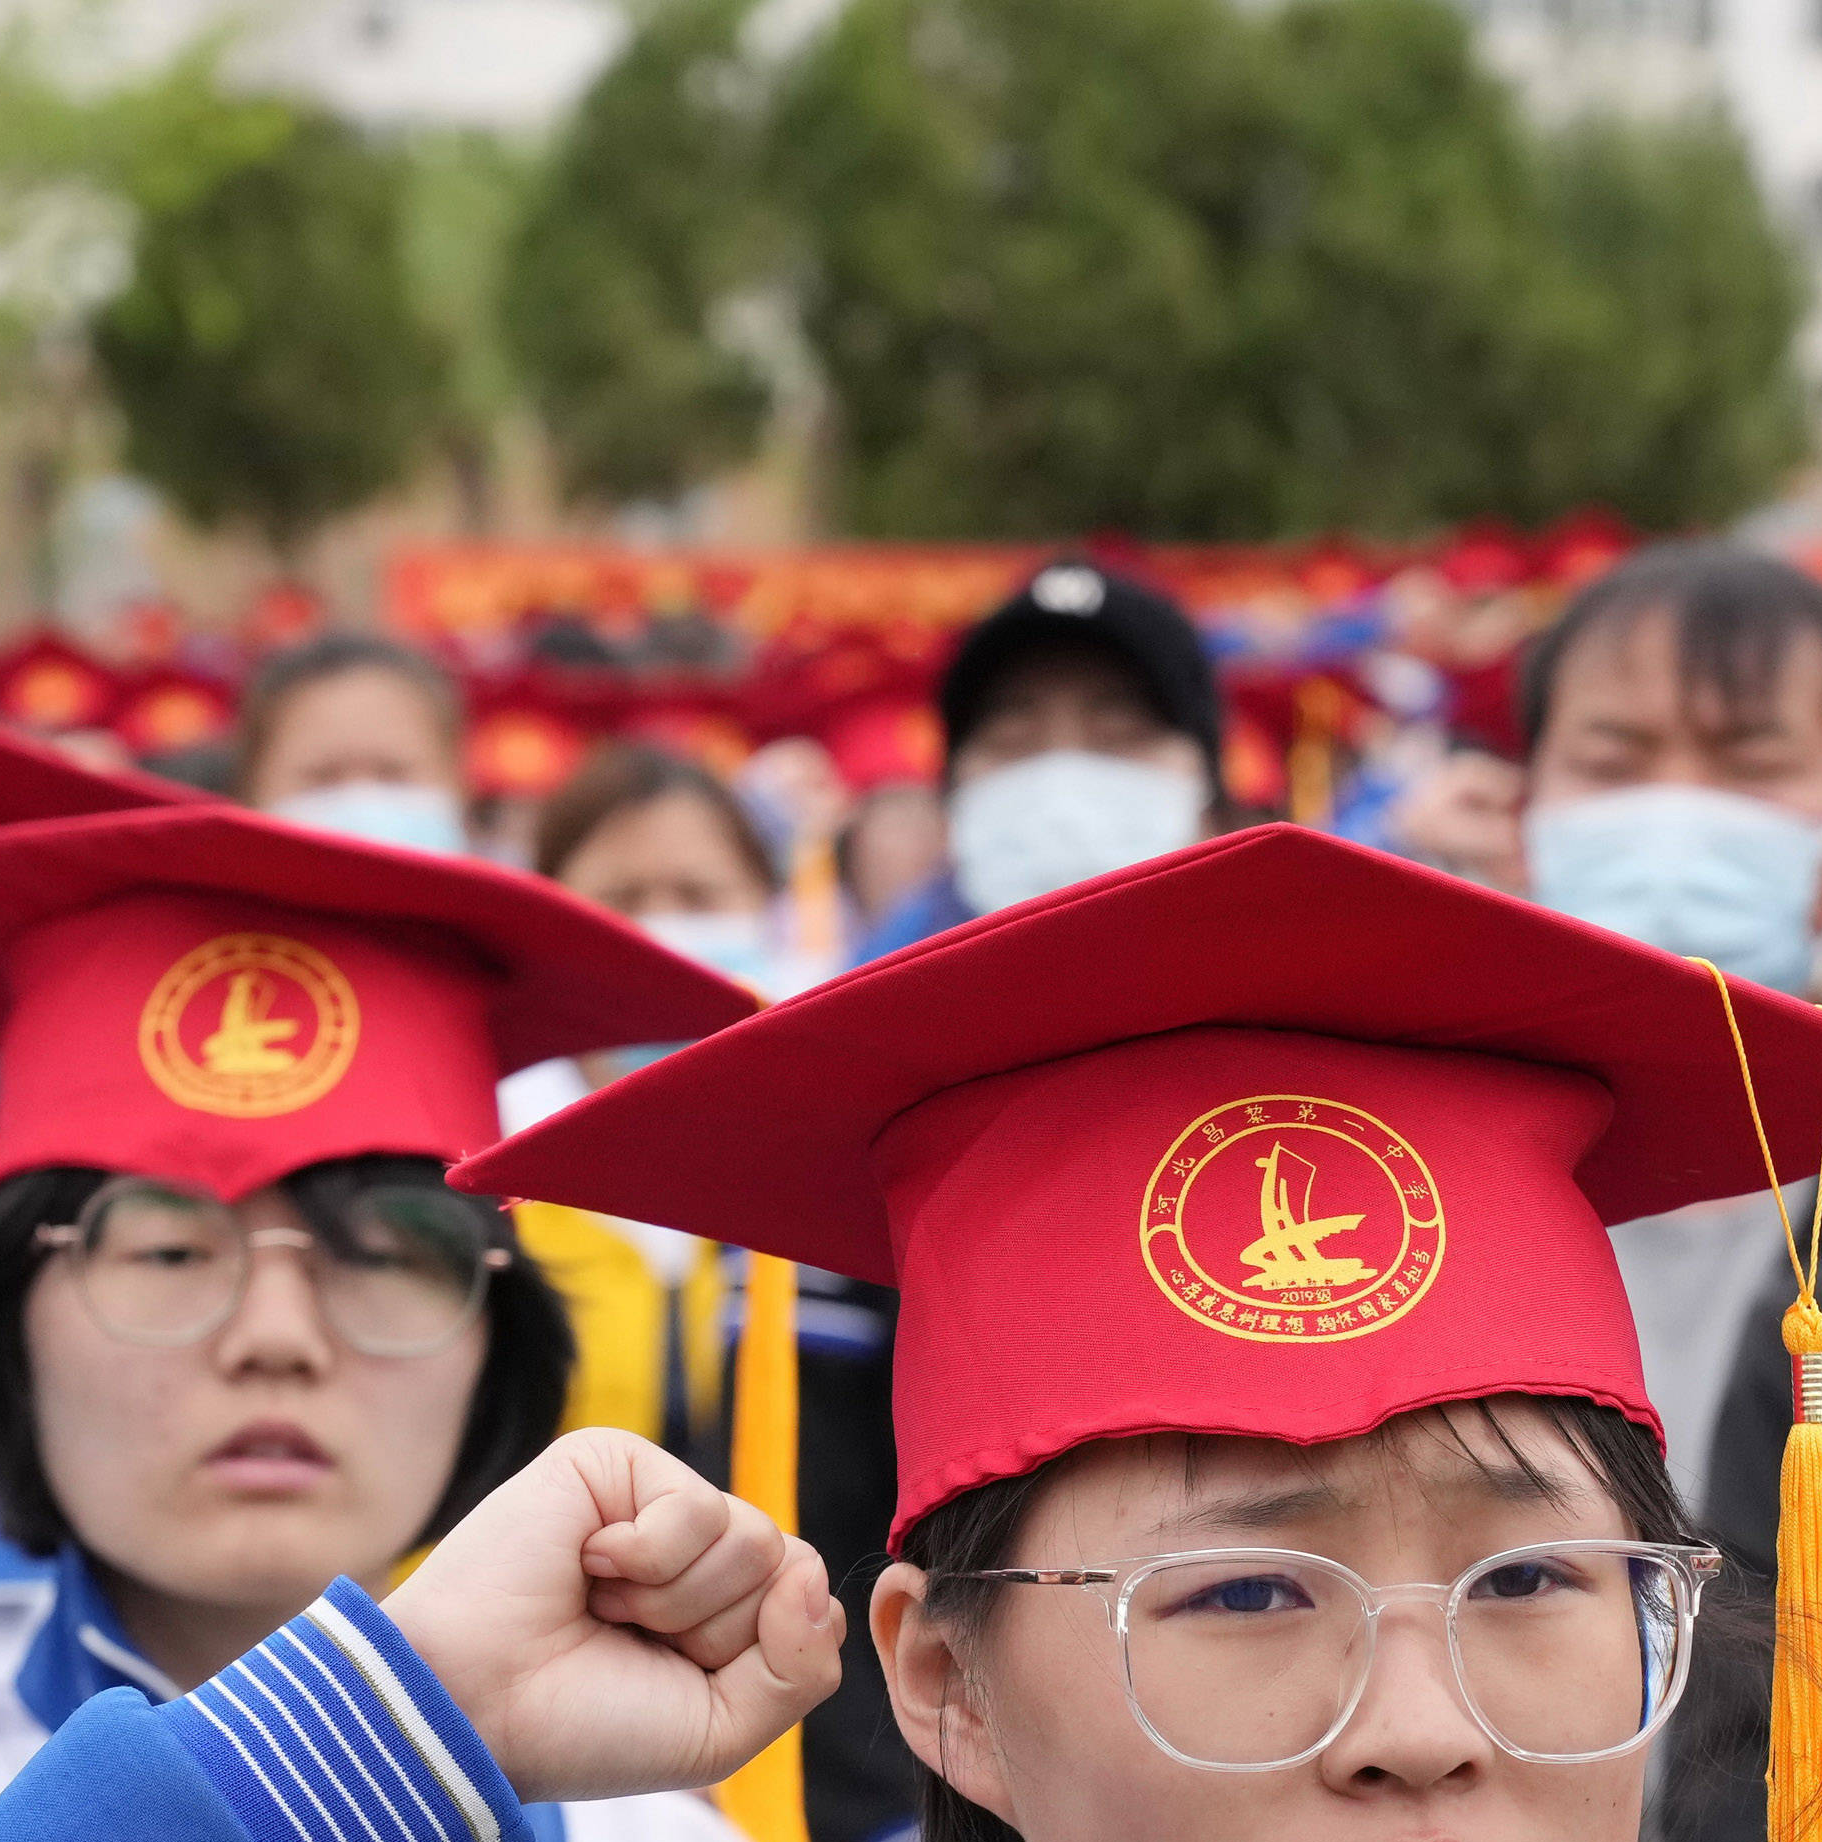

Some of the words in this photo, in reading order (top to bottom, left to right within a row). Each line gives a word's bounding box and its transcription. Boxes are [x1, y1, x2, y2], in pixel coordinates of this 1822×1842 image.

[1152, 1103, 1430, 1215] 河北昌黎第一中学
[1280, 1288, 1331, 1303] 2019级
